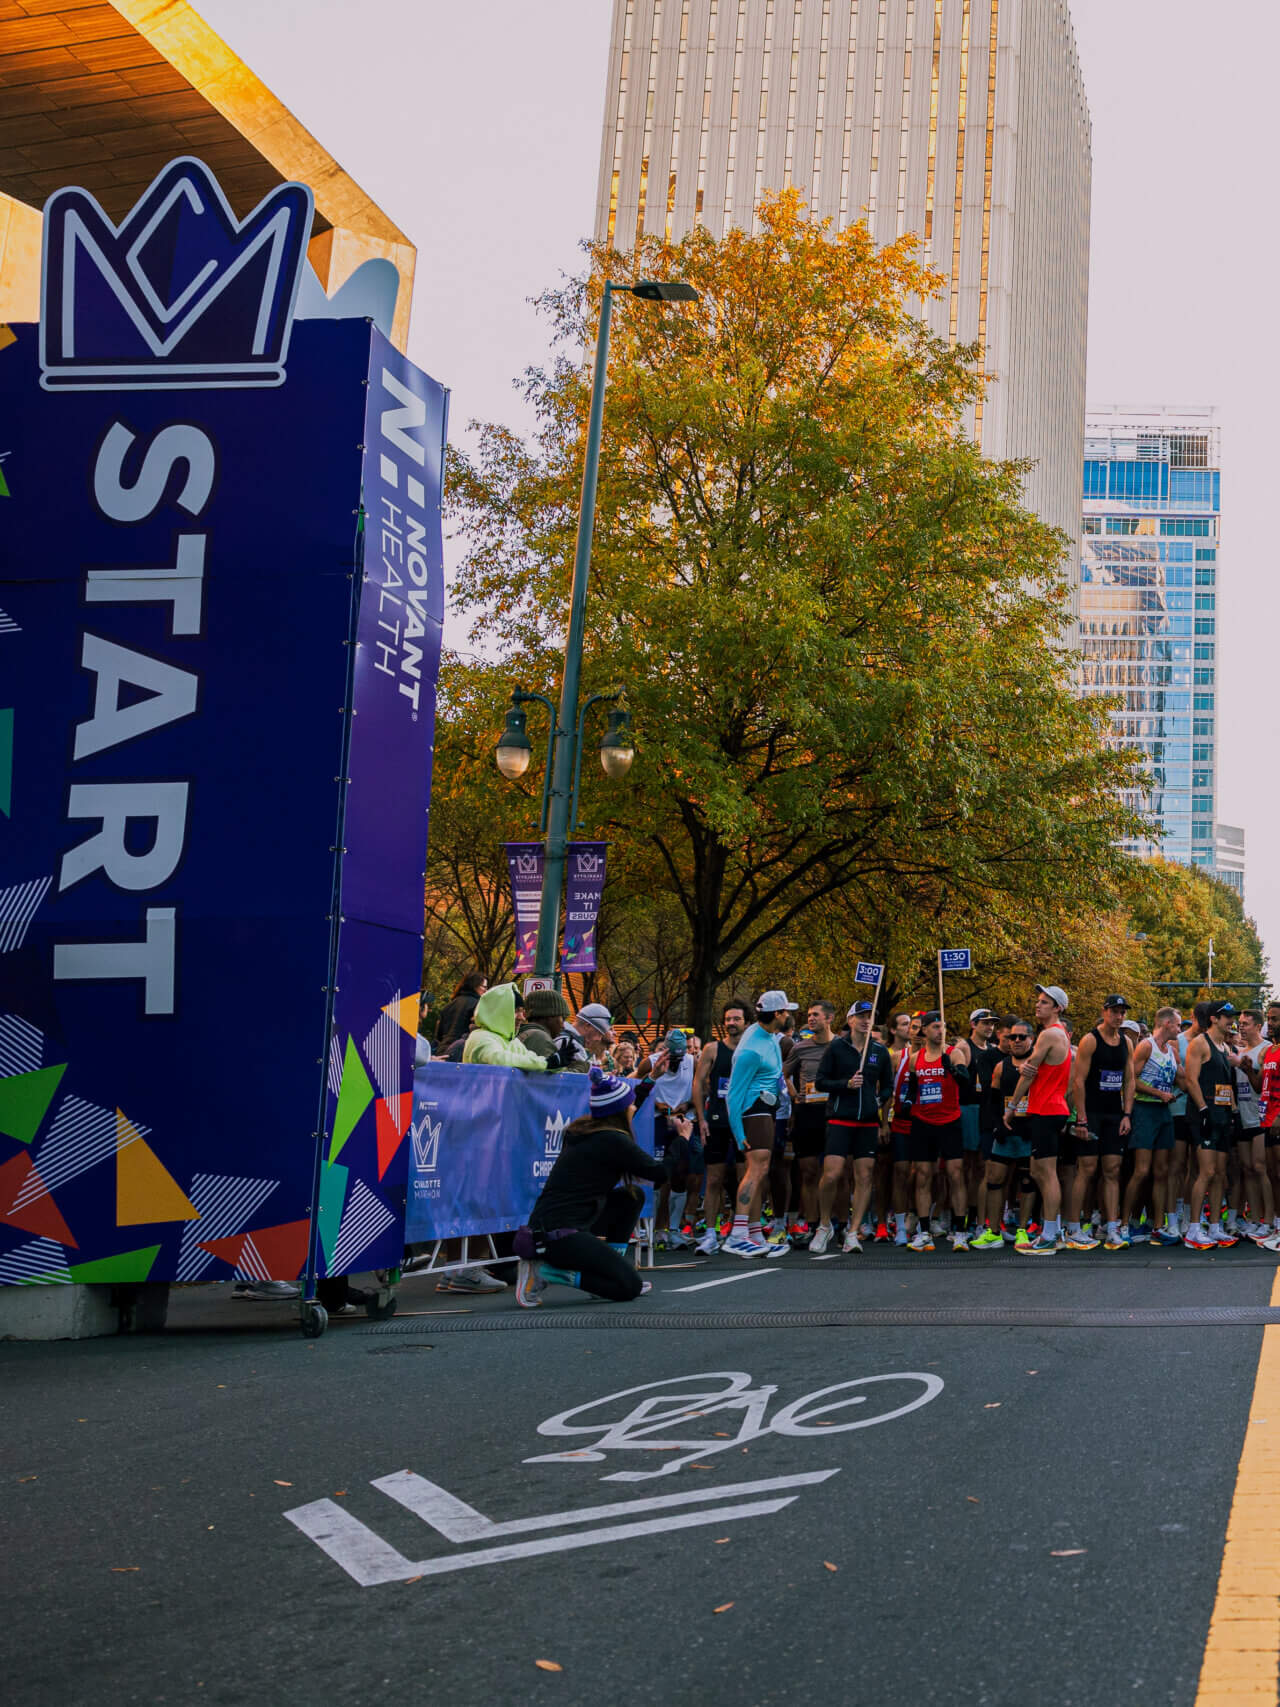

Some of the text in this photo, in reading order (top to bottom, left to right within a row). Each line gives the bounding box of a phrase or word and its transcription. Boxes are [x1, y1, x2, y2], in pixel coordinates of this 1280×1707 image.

[374, 496, 403, 677] HEALTH
[399, 515, 428, 711] NOVANT
[53, 421, 215, 1014] START
[859, 965, 879, 976] 3:00
[943, 952, 966, 961] 1:30
